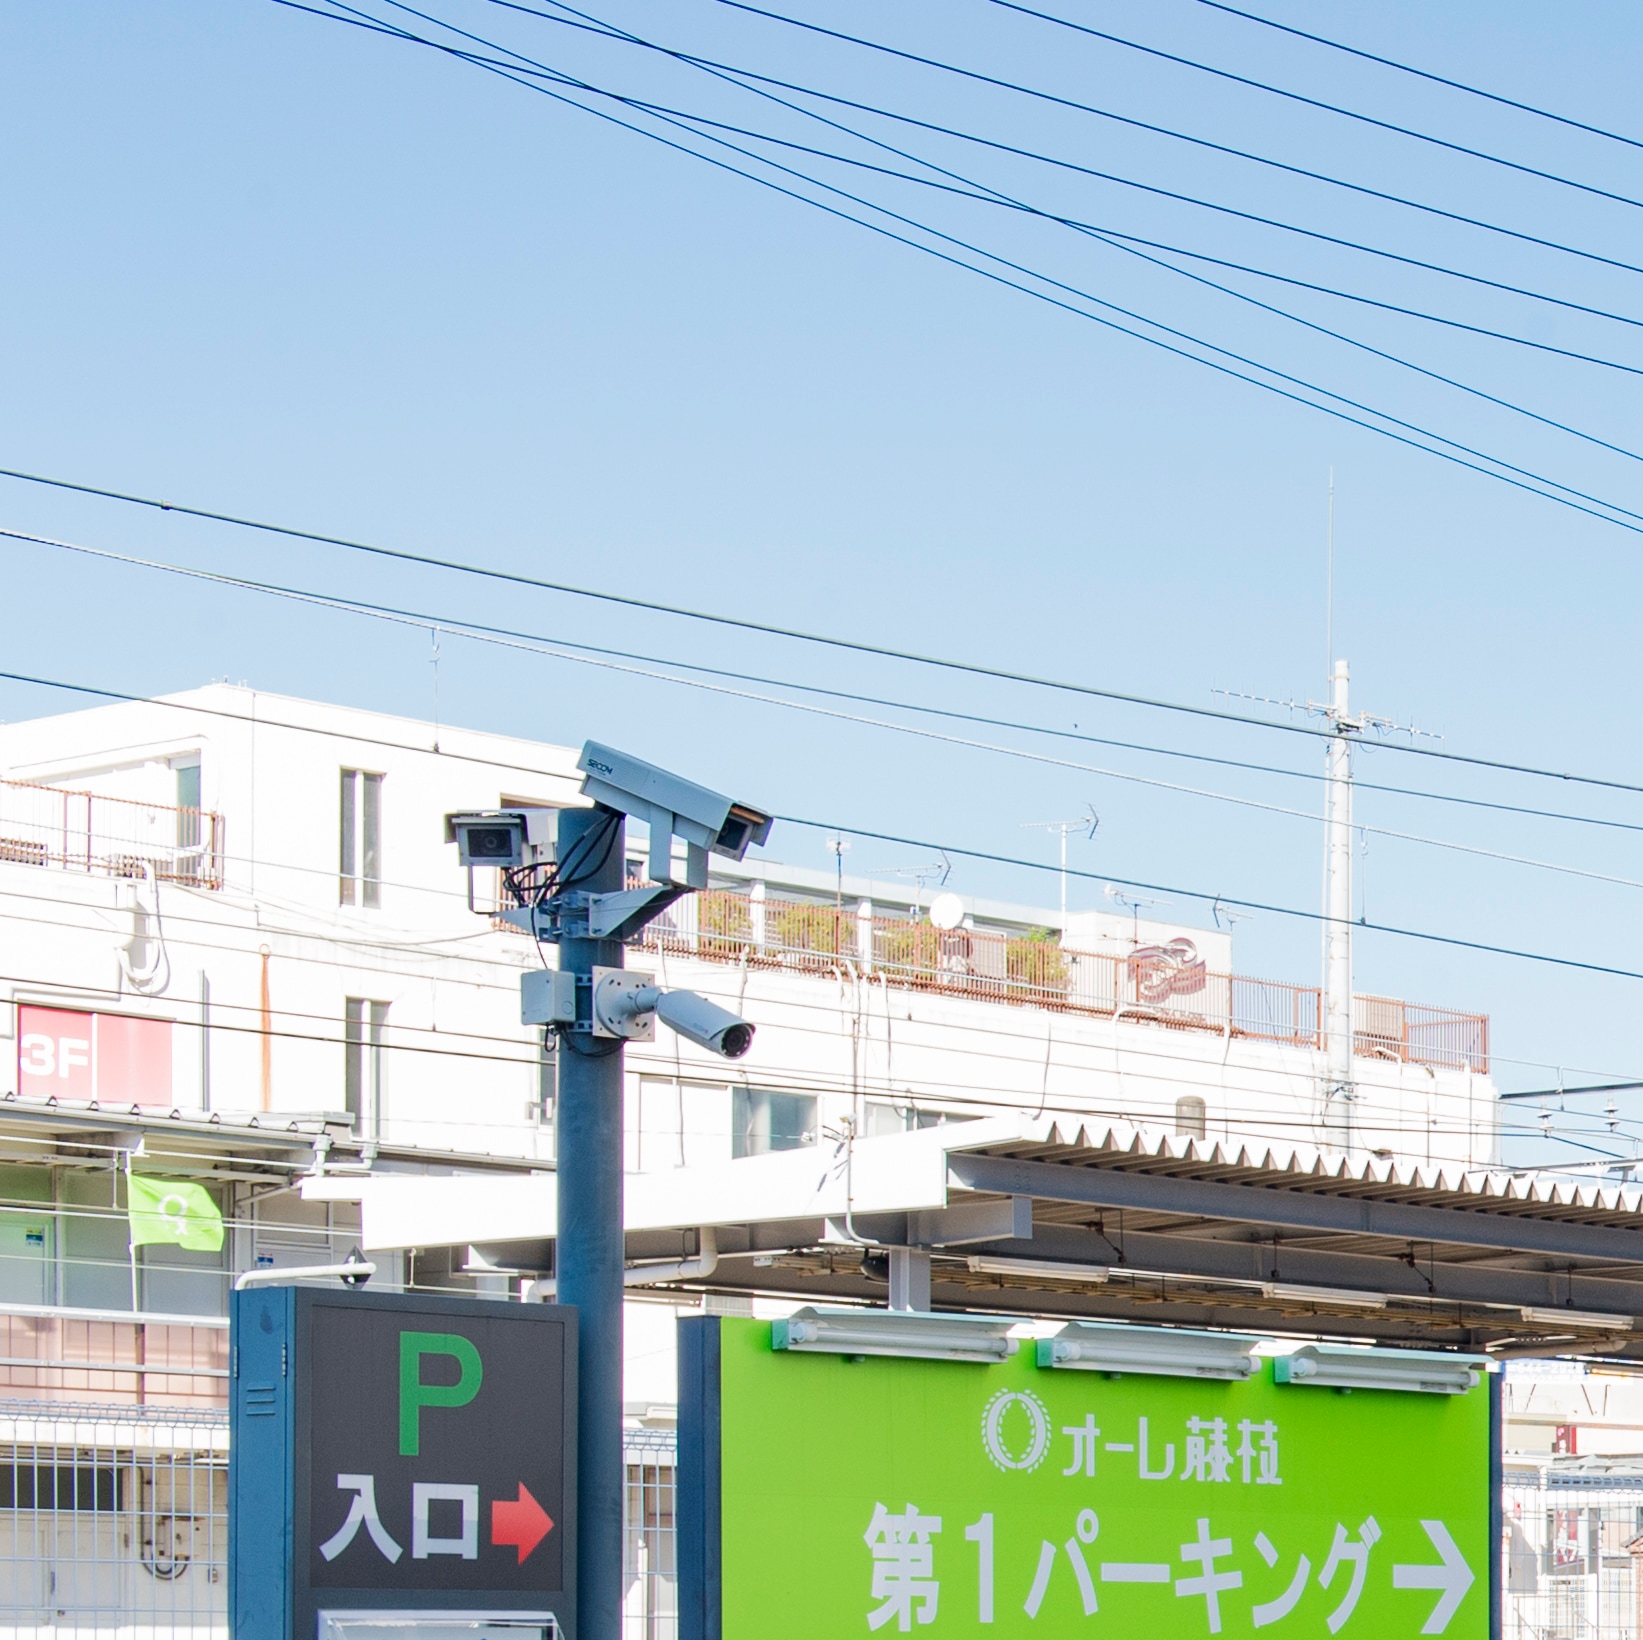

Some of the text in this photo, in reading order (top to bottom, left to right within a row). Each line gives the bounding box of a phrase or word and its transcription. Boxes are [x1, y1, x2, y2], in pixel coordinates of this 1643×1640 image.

[20, 1033, 90, 1079] 3F
[398, 1330, 484, 1457] P
[319, 1473, 480, 1564] 入口
[863, 1501, 1382, 1636] 第1パーキング
